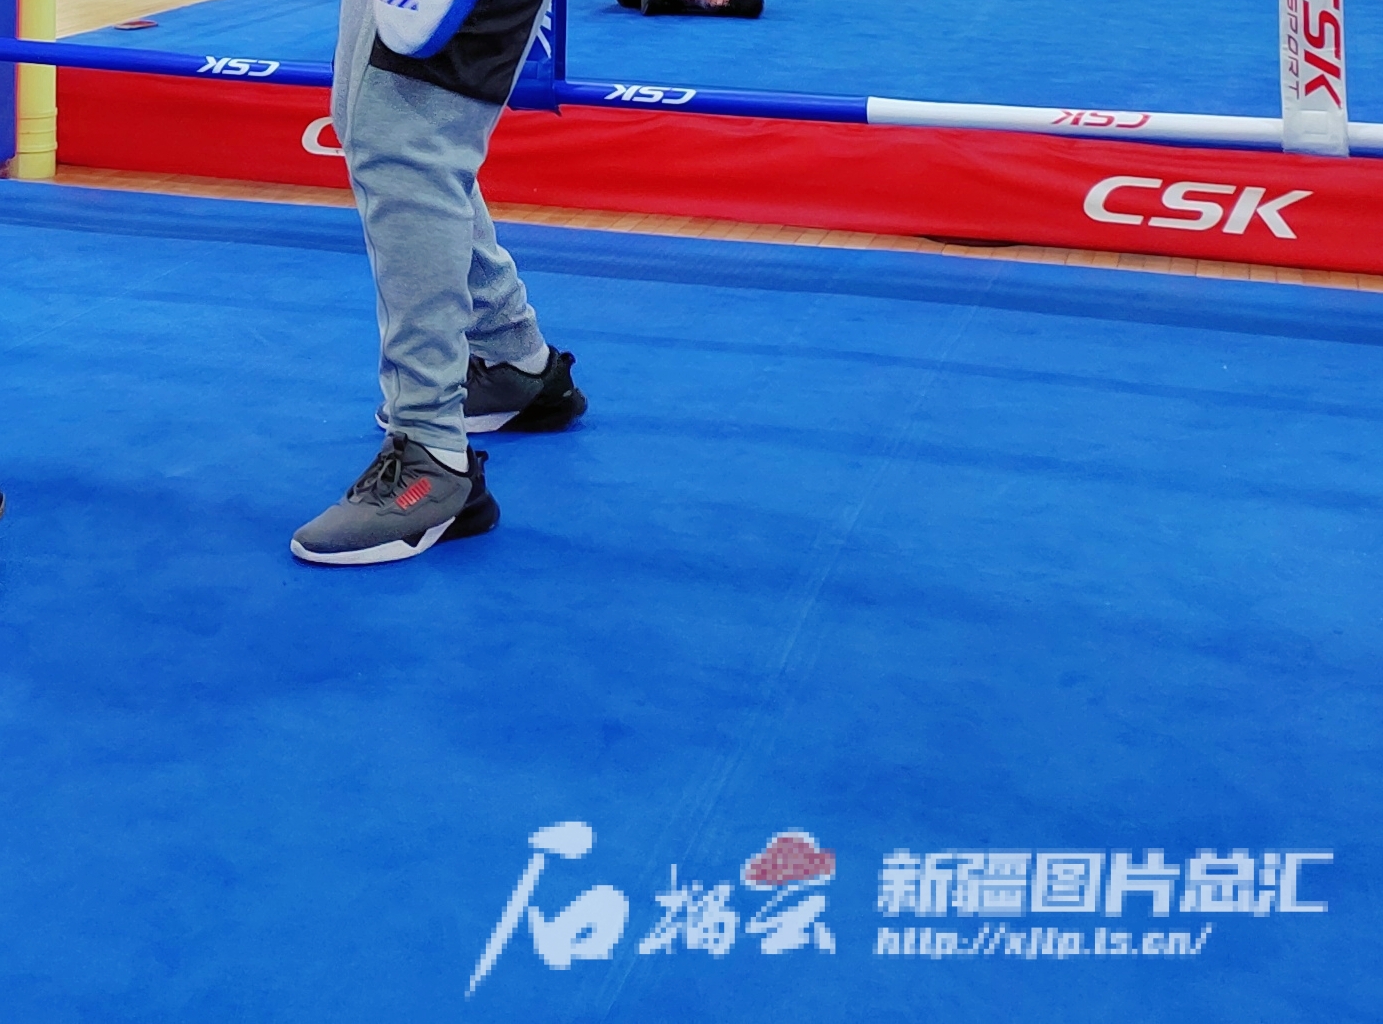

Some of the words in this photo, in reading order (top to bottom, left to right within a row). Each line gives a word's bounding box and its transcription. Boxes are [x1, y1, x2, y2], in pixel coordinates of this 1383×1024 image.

[196, 56, 280, 77] CSK
[604, 84, 697, 105] CSK
[1051, 110, 1152, 129] CSK
[1083, 175, 1314, 240] CSK
